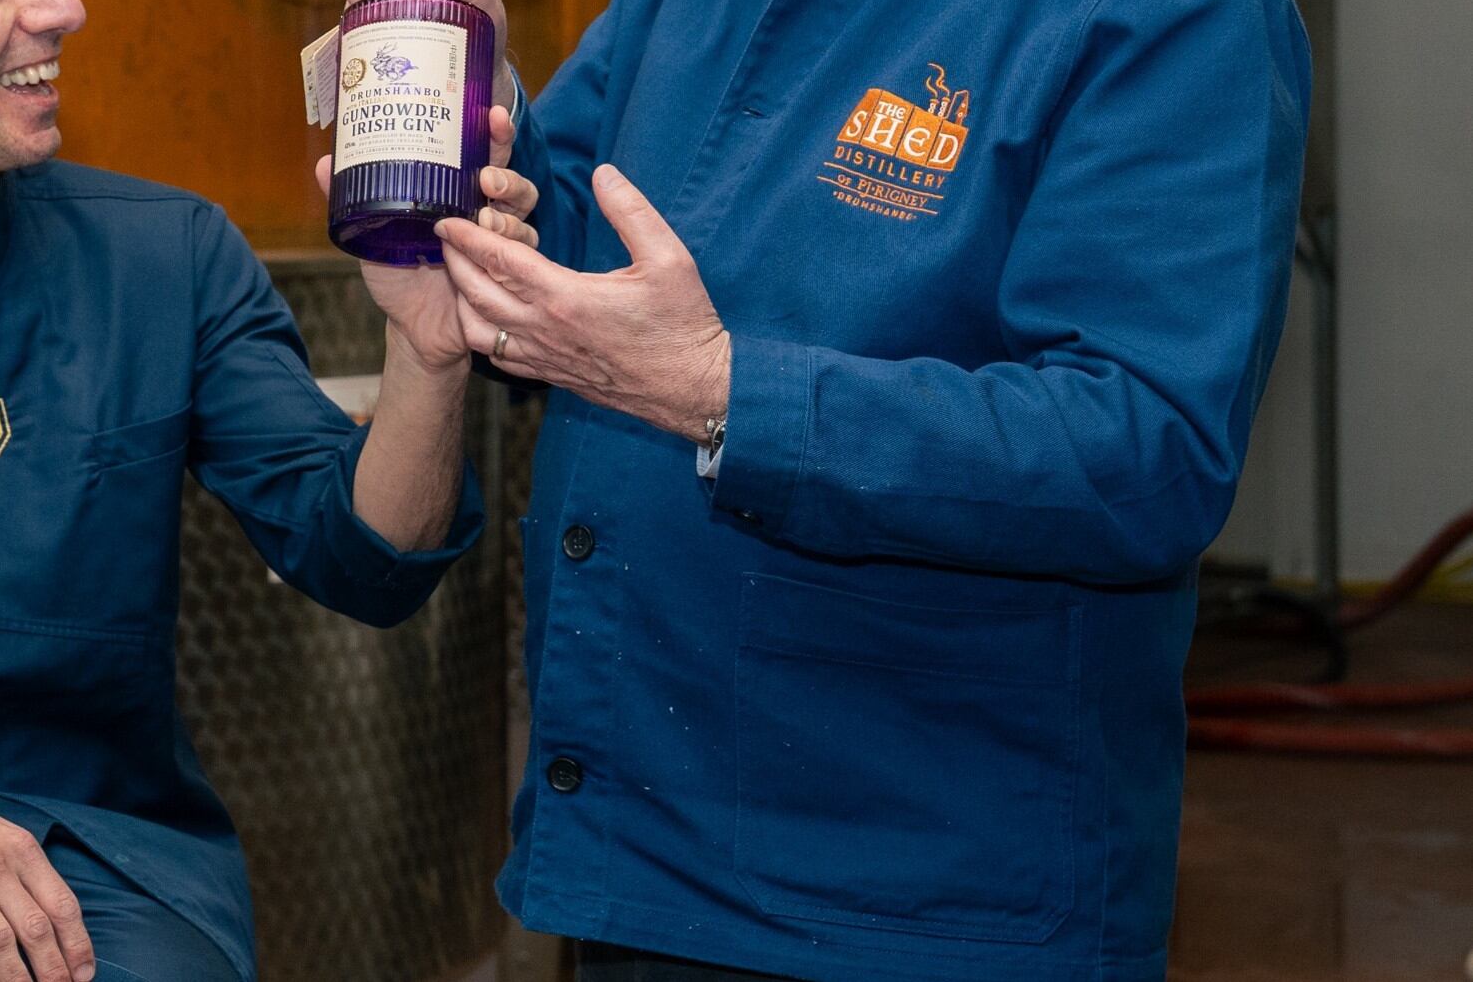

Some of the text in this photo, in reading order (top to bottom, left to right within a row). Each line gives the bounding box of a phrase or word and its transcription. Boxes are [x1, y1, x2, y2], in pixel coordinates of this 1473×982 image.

[350, 85, 441, 103] DRUMSHANBO
[342, 103, 451, 126] GUNPOWDER
[877, 101, 906, 118] THE
[352, 118, 395, 137] IRISH
[846, 110, 959, 163] SHED
[834, 145, 946, 189] DISTILLERY
[837, 174, 852, 186] OF
